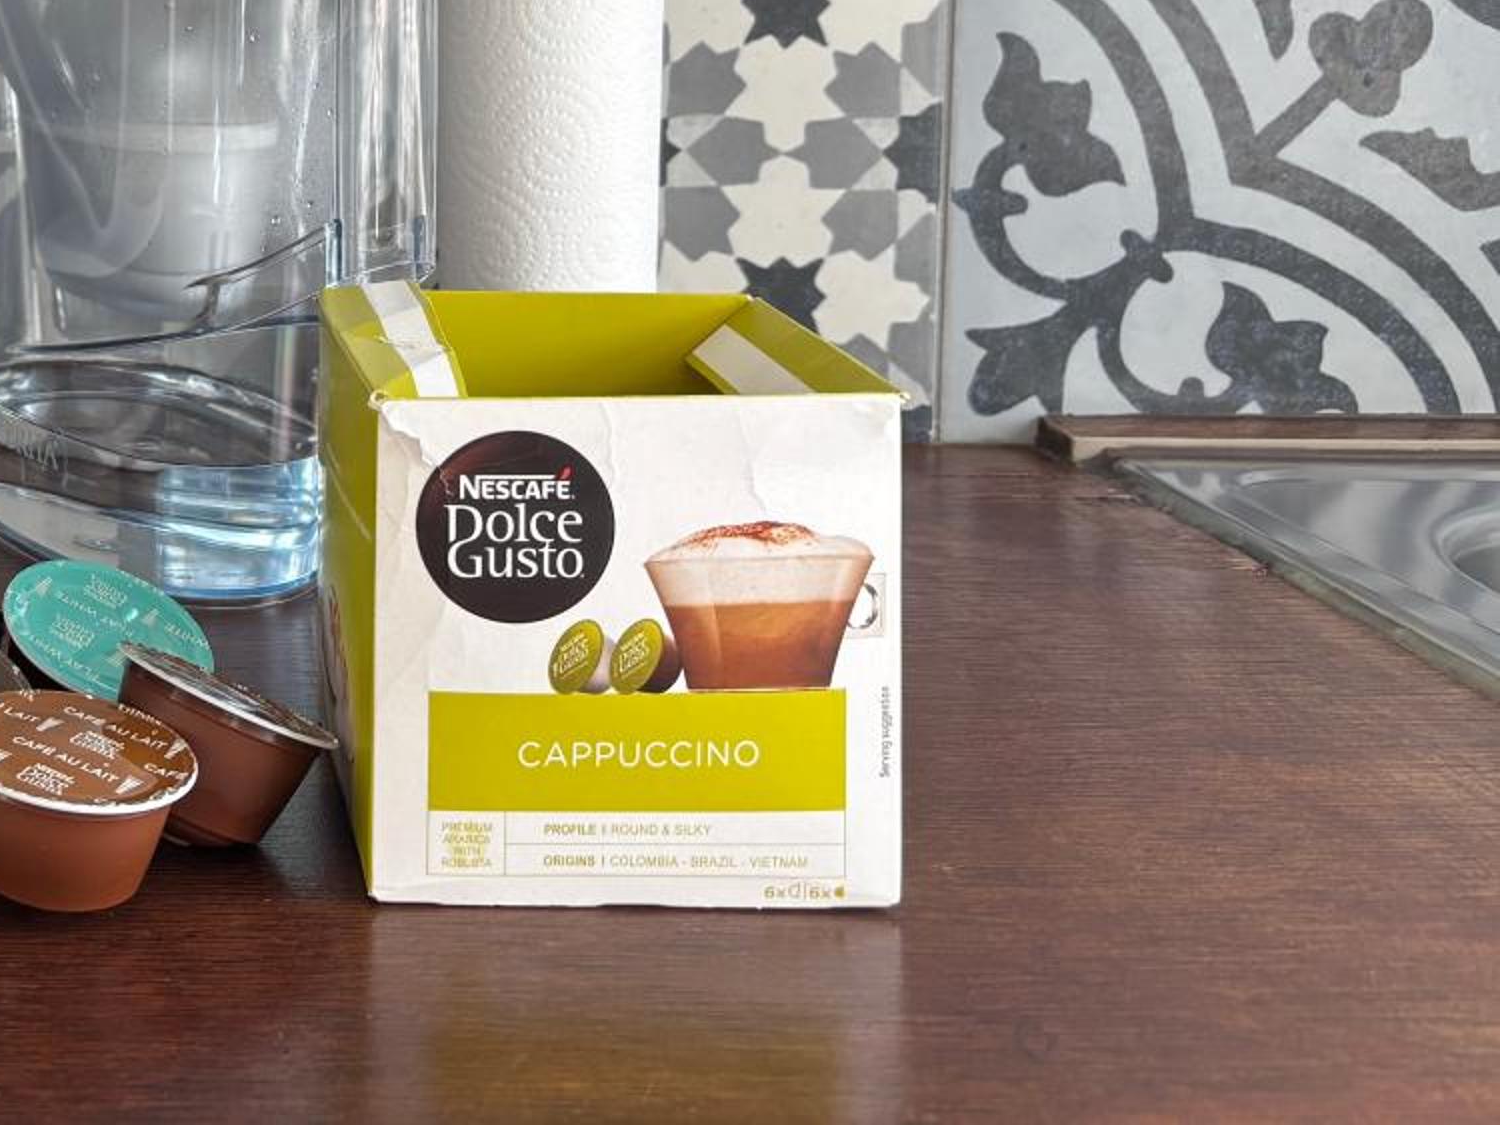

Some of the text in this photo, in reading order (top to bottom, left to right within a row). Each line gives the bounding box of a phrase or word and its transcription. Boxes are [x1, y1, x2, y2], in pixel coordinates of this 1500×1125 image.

[459, 465, 573, 500] NESCAFÉ
[444, 502, 583, 543] Dolce
[447, 541, 584, 579] Gusto
[4, 706, 41, 723] LAIT
[63, 706, 107, 725] CAFÉ
[105, 724, 132, 736] AU
[129, 732, 169, 750] LAIT
[12, 736, 120, 783] CAFÉ AU LAIT
[517, 740, 760, 768] CAPPUCCINO
[544, 823, 597, 836] PROFILE
[611, 824, 660, 836] ROUND
[661, 824, 670, 836] &
[674, 824, 711, 836] SILKY
[543, 855, 595, 868] ORIGINS
[609, 856, 677, 868] COLOMBIA
[690, 856, 737, 868] BRAZIL
[749, 856, 808, 869] VIETNAM
